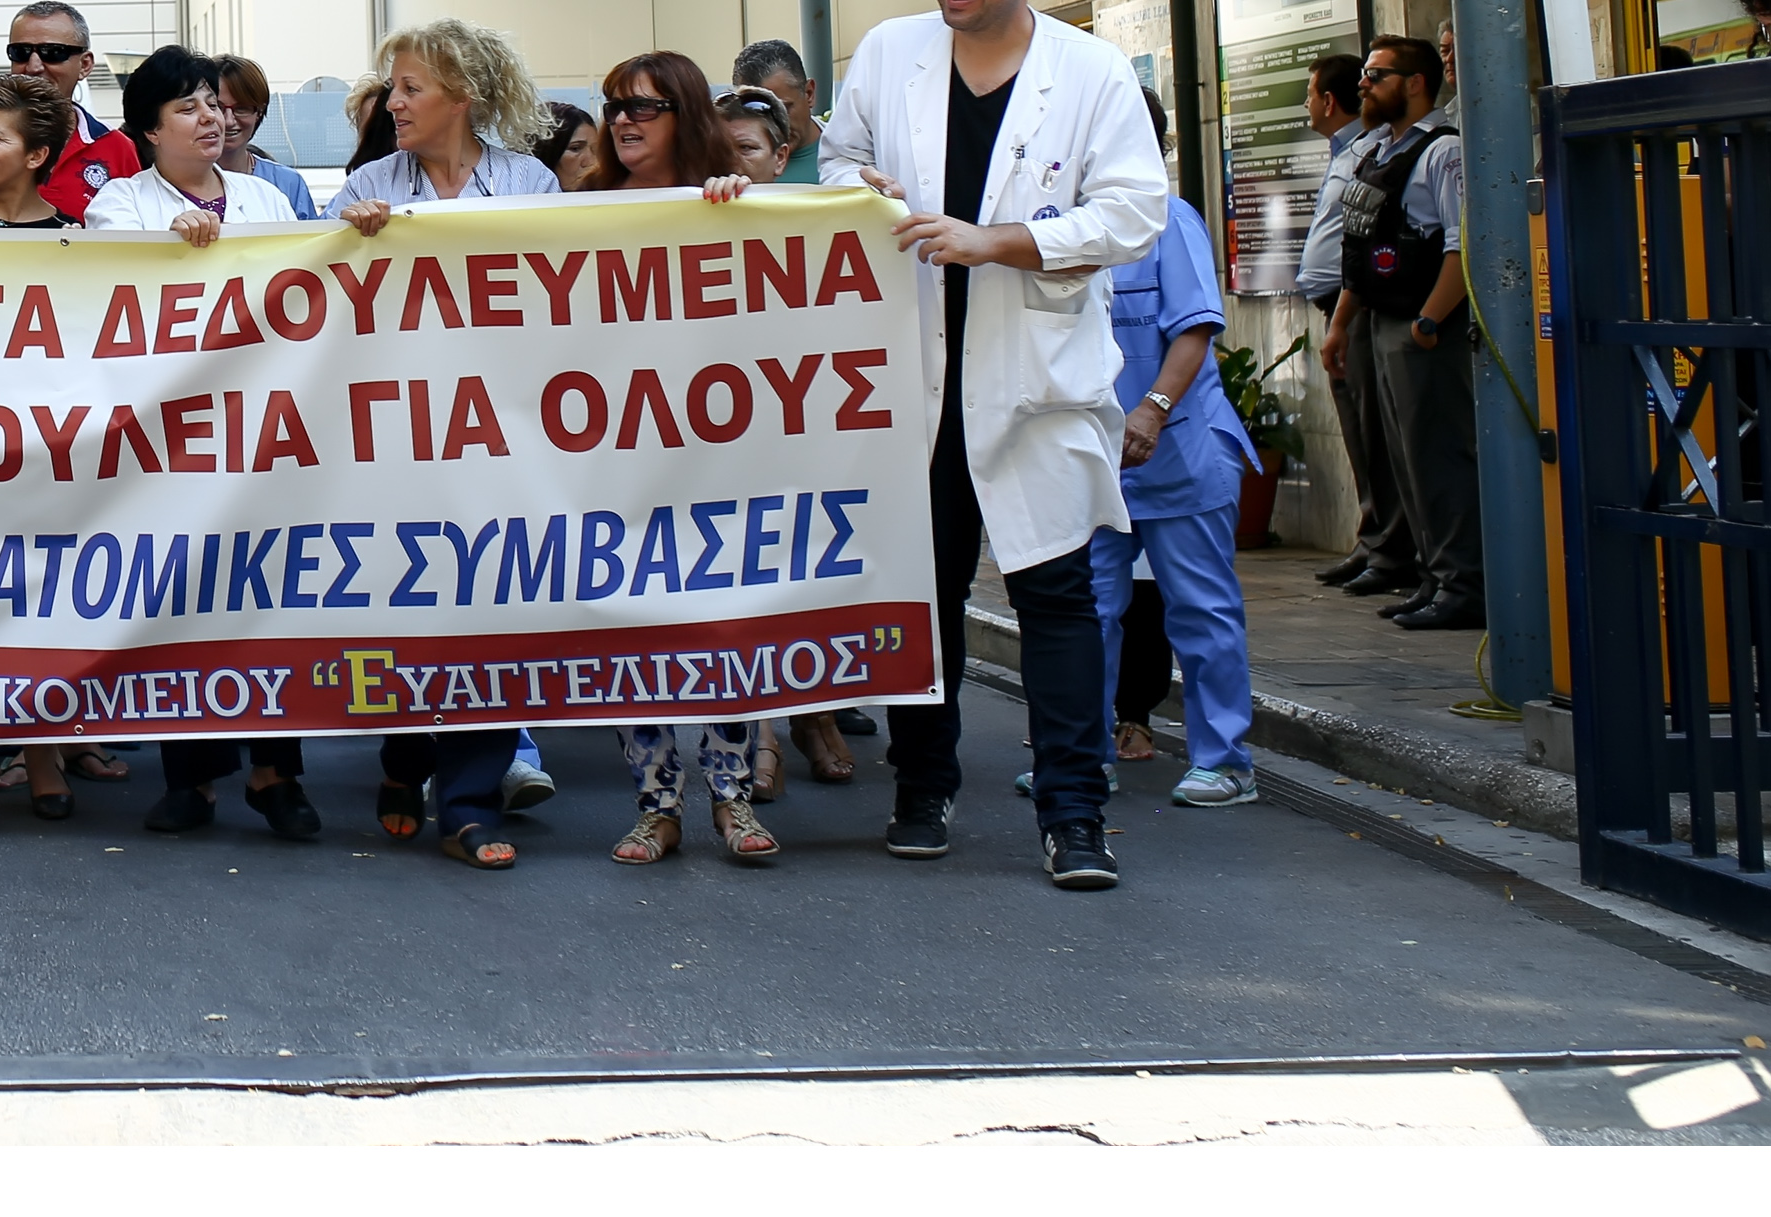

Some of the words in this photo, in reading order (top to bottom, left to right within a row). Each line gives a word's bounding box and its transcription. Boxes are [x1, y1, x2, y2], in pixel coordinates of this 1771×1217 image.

[91, 230, 884, 359] ΔΕΔΟΥΛΕΥΜΕΝΑ
[348, 375, 511, 463] ΓΙΑ
[540, 347, 894, 454] ΟΛΟΥΣ
[388, 488, 870, 609] ΣΥΜΒΑΣΕΙΣ
